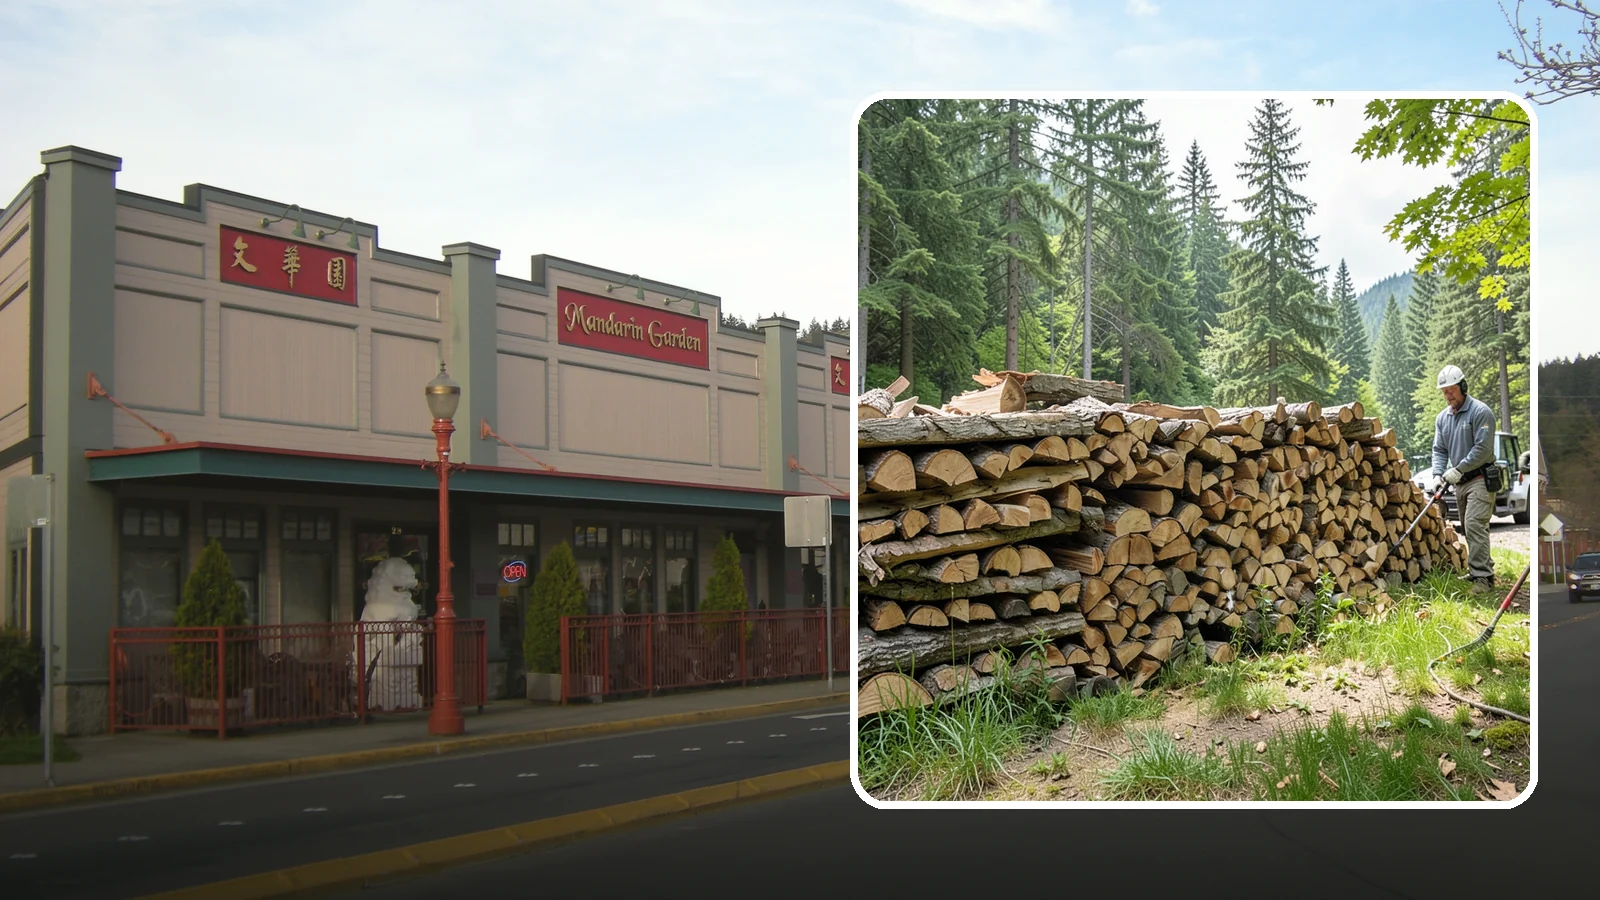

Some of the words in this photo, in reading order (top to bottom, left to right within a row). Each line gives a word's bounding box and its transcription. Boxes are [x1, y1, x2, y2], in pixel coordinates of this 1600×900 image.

[230, 235, 346, 291] 文華園
[564, 302, 644, 341] Mandarin
[647, 320, 702, 352] Garden
[834, 362, 847, 386] 文
[503, 565, 527, 578] OPEN
